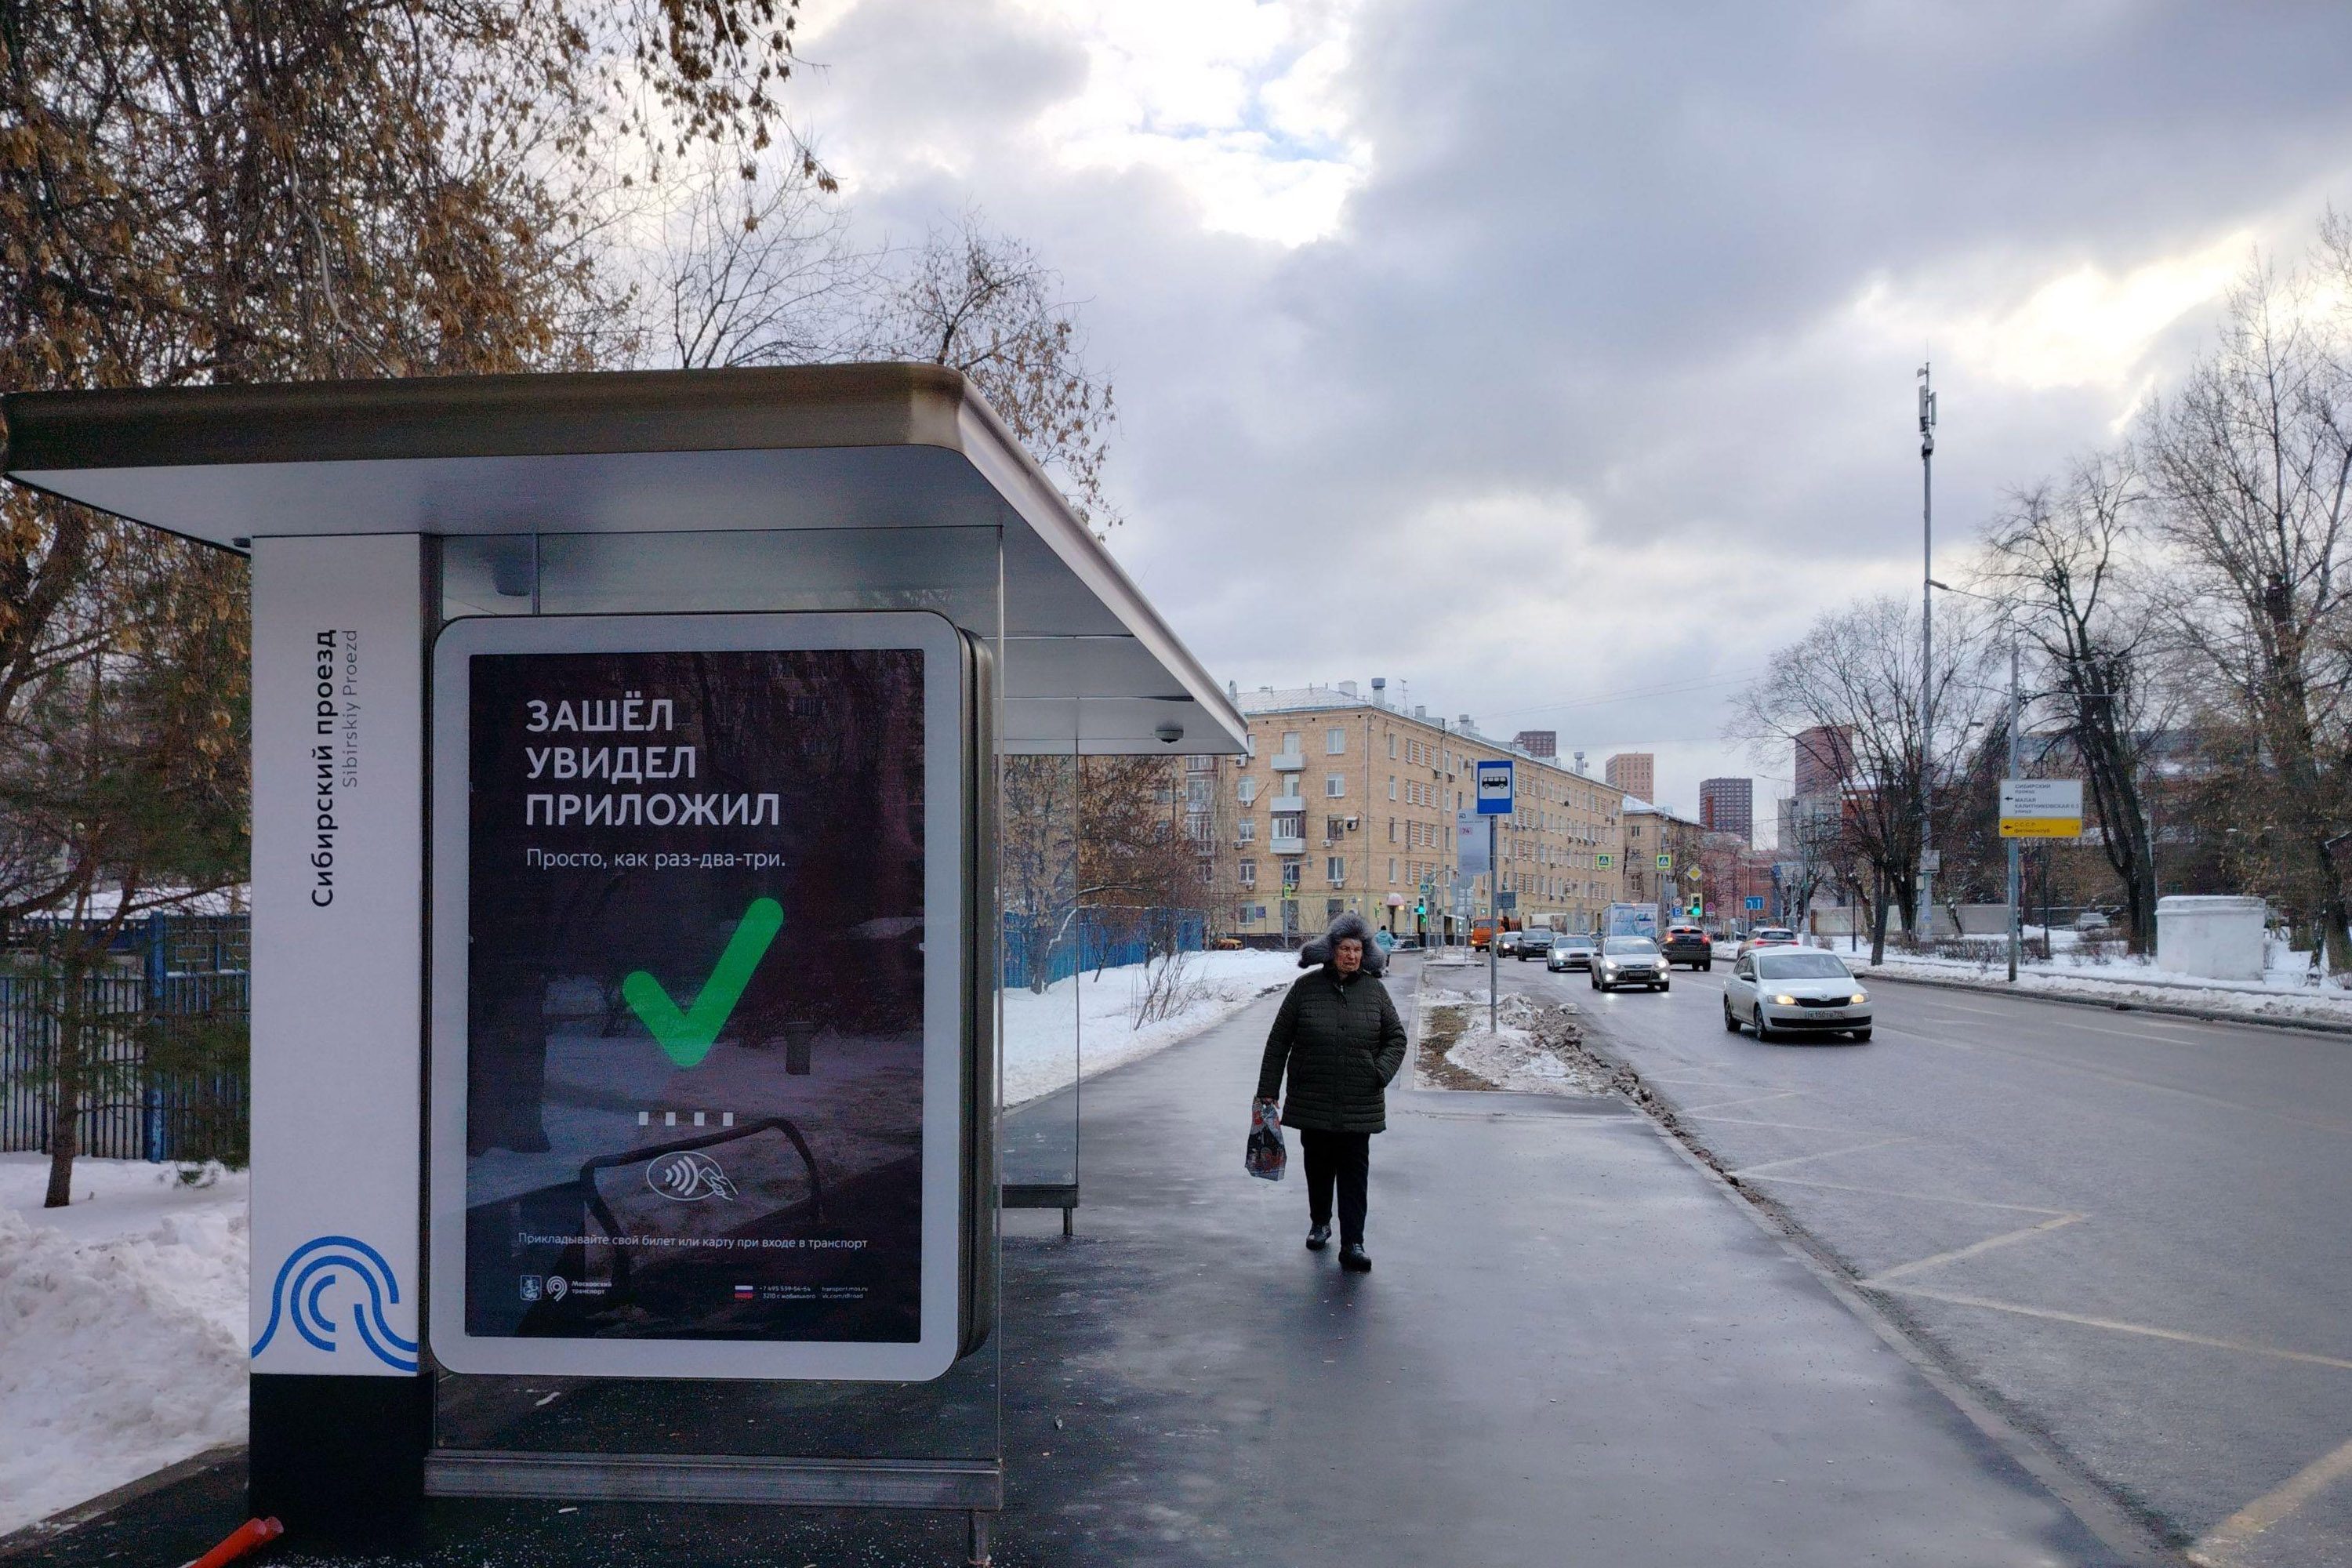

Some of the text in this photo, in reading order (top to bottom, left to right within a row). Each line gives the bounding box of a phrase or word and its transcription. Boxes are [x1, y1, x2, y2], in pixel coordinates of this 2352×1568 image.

[343, 630, 361, 788] Sibirskiy Proezd
[525, 691, 673, 731] ЗАШЁЛ
[311, 630, 338, 907] Сибирский проезд
[525, 746, 696, 784] УВИДЕЛ
[525, 793, 780, 826] ПРИЛОЖИЛ
[527, 848, 786, 870] Просто, как раз-два-три.
[518, 1232, 868, 1250] Прикладывайте свой билет или карту при входе в транспорт
